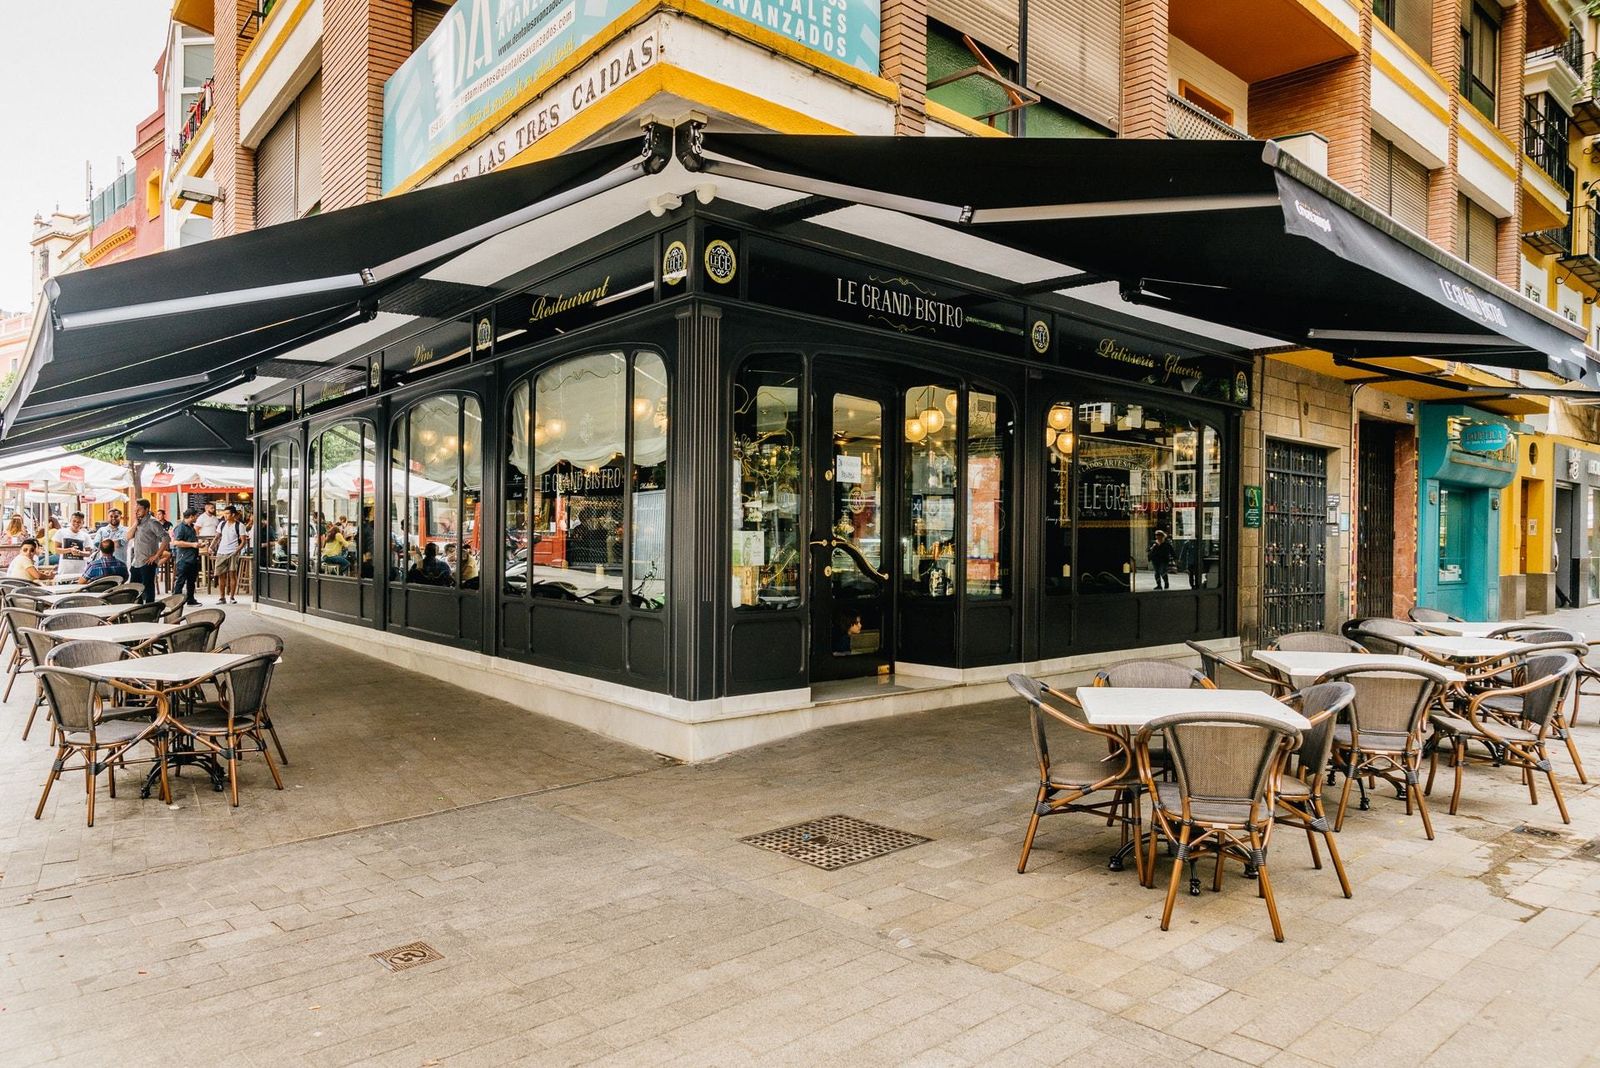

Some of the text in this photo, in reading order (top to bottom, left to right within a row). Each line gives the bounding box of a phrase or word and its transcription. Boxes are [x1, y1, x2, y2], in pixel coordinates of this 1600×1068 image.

[779, 0, 847, 34] ALES
[479, 141, 506, 176] LAS
[516, 104, 560, 151] TRES
[572, 36, 654, 111] CAIDAS
[529, 275, 609, 323] Restaurant
[837, 278, 964, 329] LE GRAND BISTRO
[585, 468, 621, 490] BISTRO
[1083, 482, 1102, 510] LE
